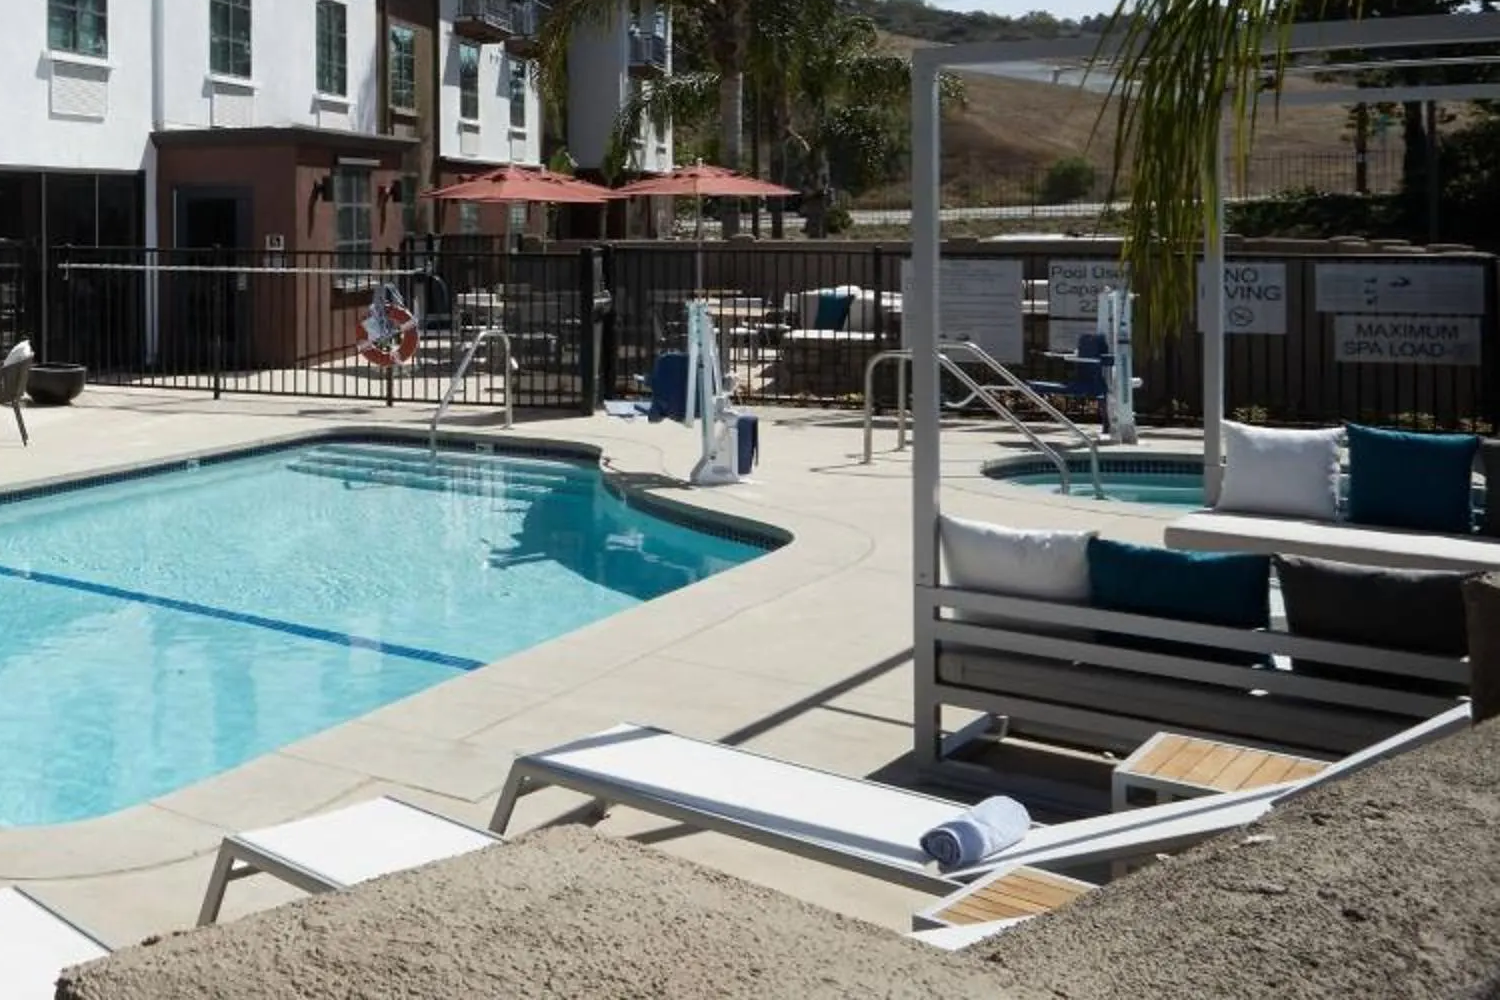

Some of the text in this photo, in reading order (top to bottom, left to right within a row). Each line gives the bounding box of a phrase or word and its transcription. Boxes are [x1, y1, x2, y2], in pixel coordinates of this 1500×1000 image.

[1051, 265, 1087, 279] Pool
[1223, 268, 1258, 284] NO
[1055, 282, 1118, 298] Capa
[1355, 323, 1459, 341] MAXIMUM
[1344, 340, 1384, 356] SPA
